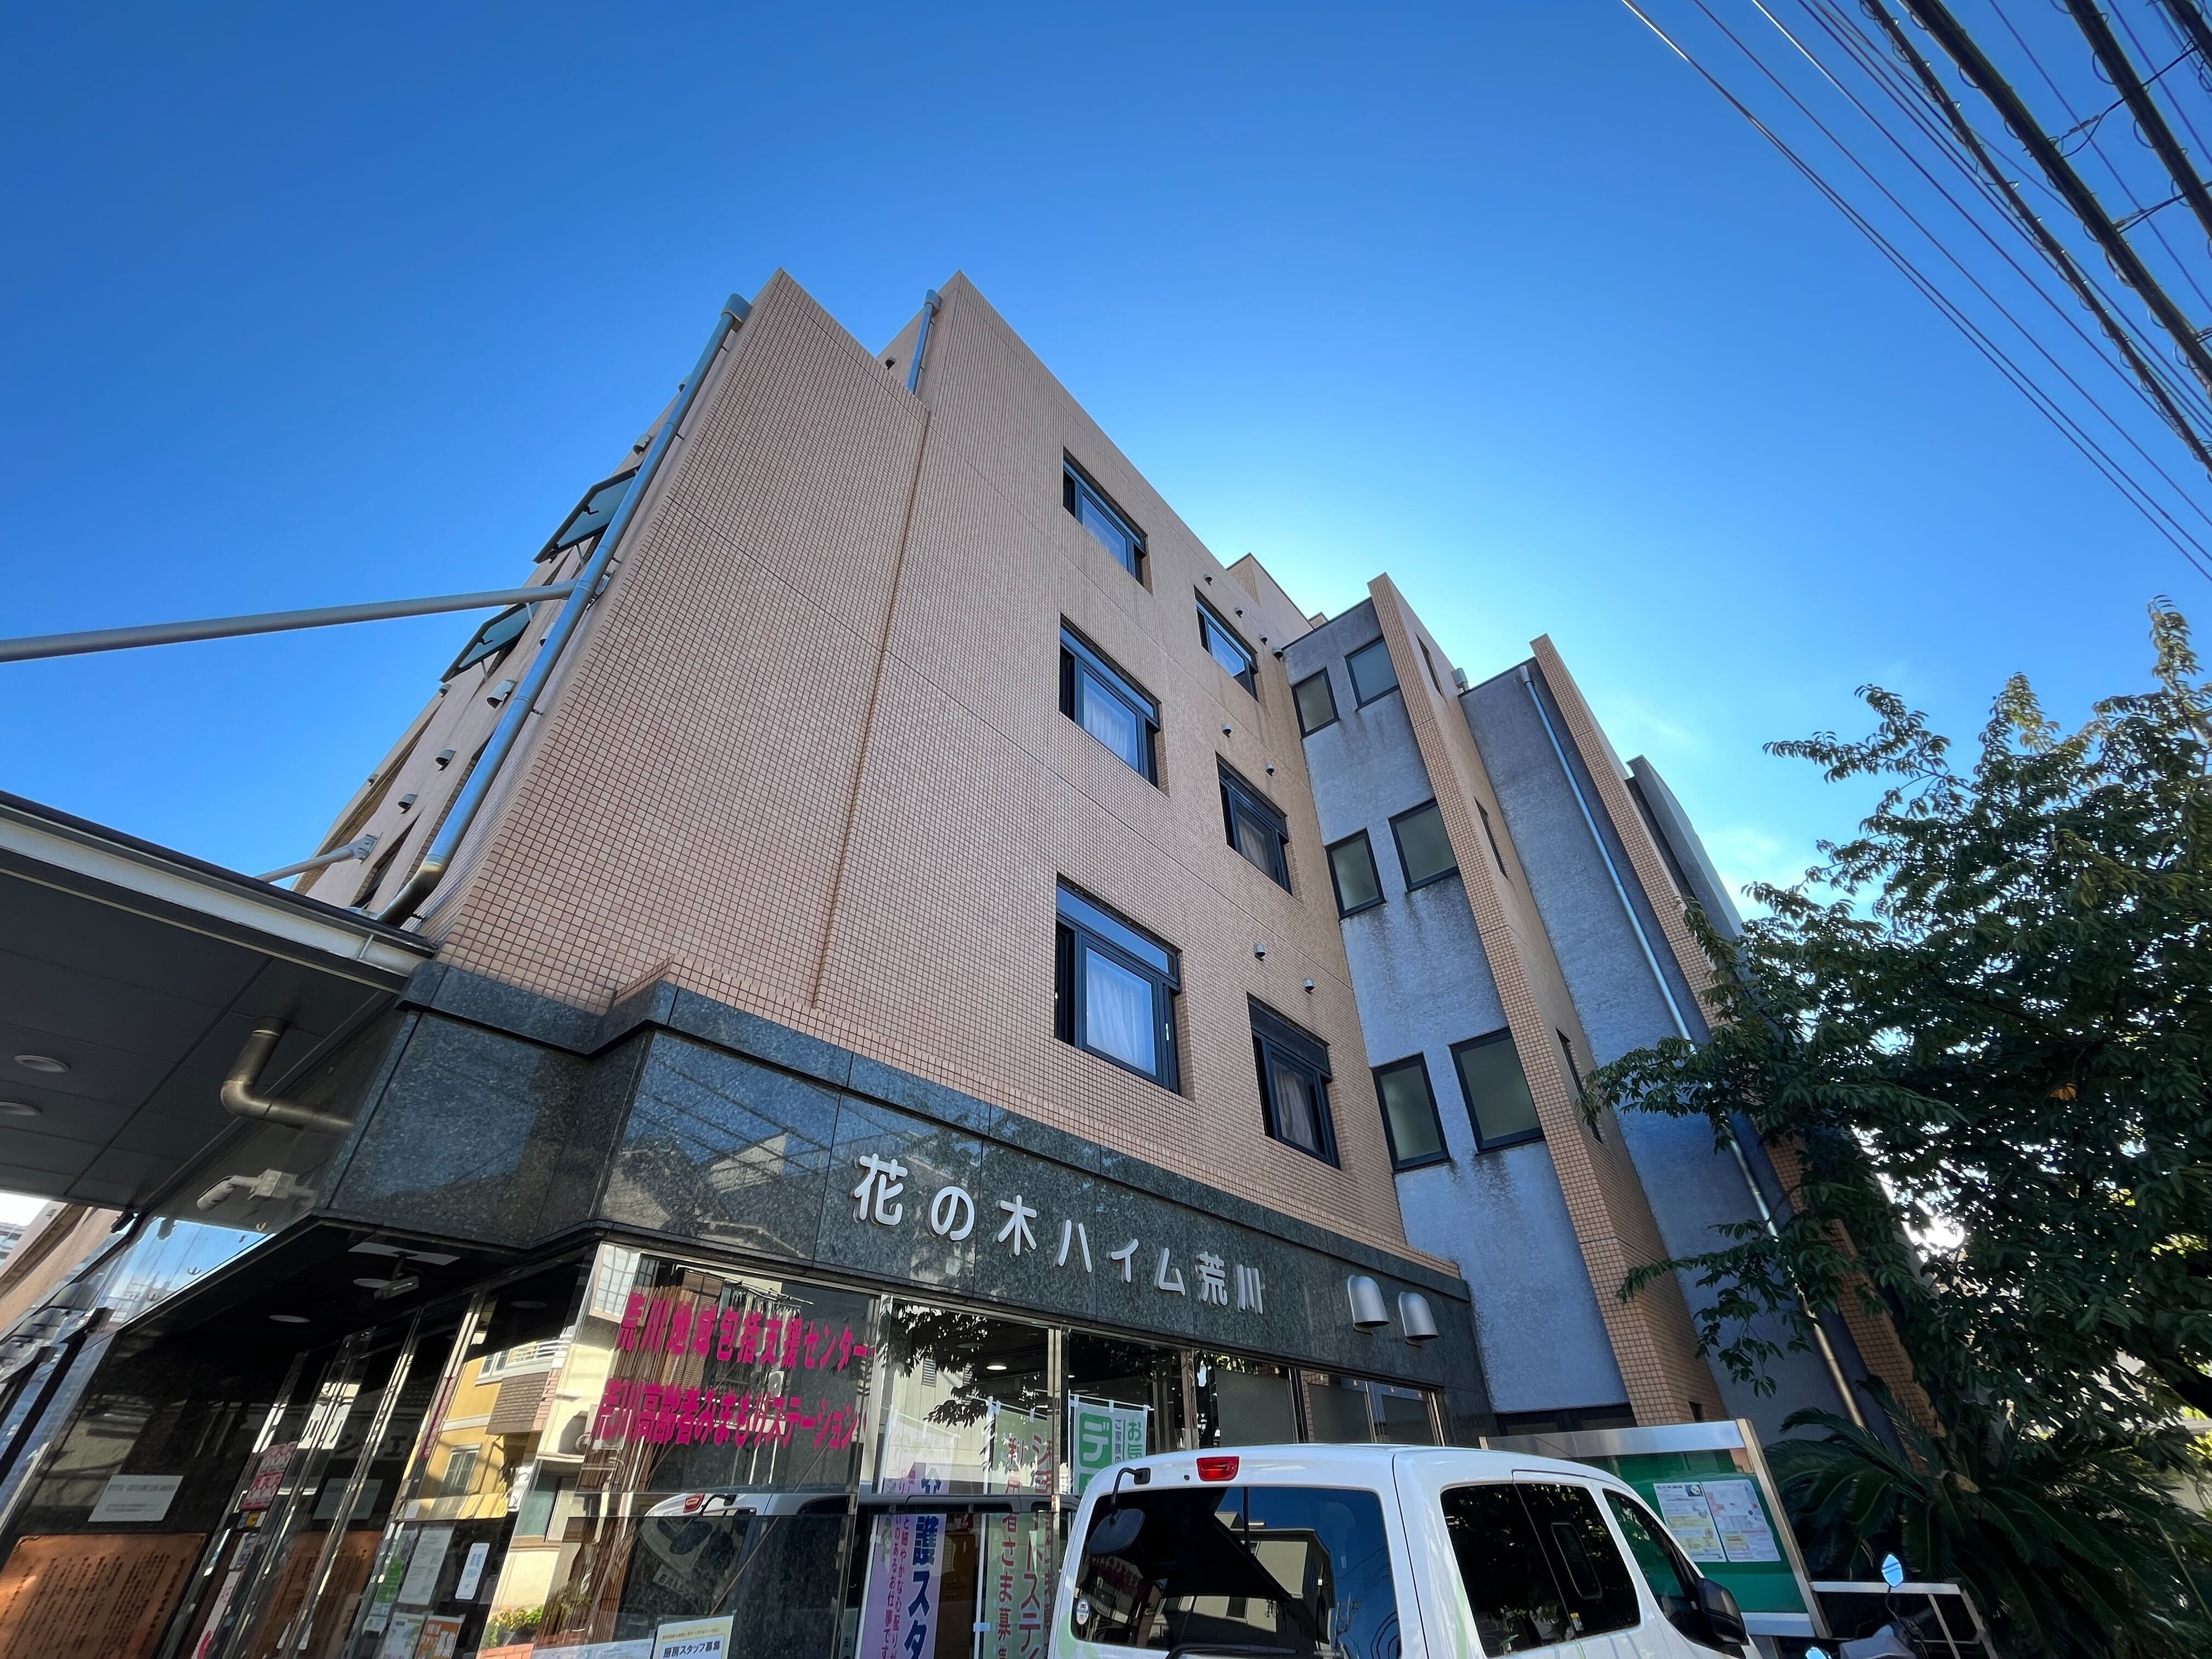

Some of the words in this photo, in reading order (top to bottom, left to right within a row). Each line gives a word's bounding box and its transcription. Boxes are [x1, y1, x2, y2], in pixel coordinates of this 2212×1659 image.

[853, 1153, 1263, 1314] 花の木ハイム荒川
[617, 1294, 867, 1372] 荒川地域包括支援センター
[591, 1378, 860, 1450] 荒川高齢者みまもりステーション
